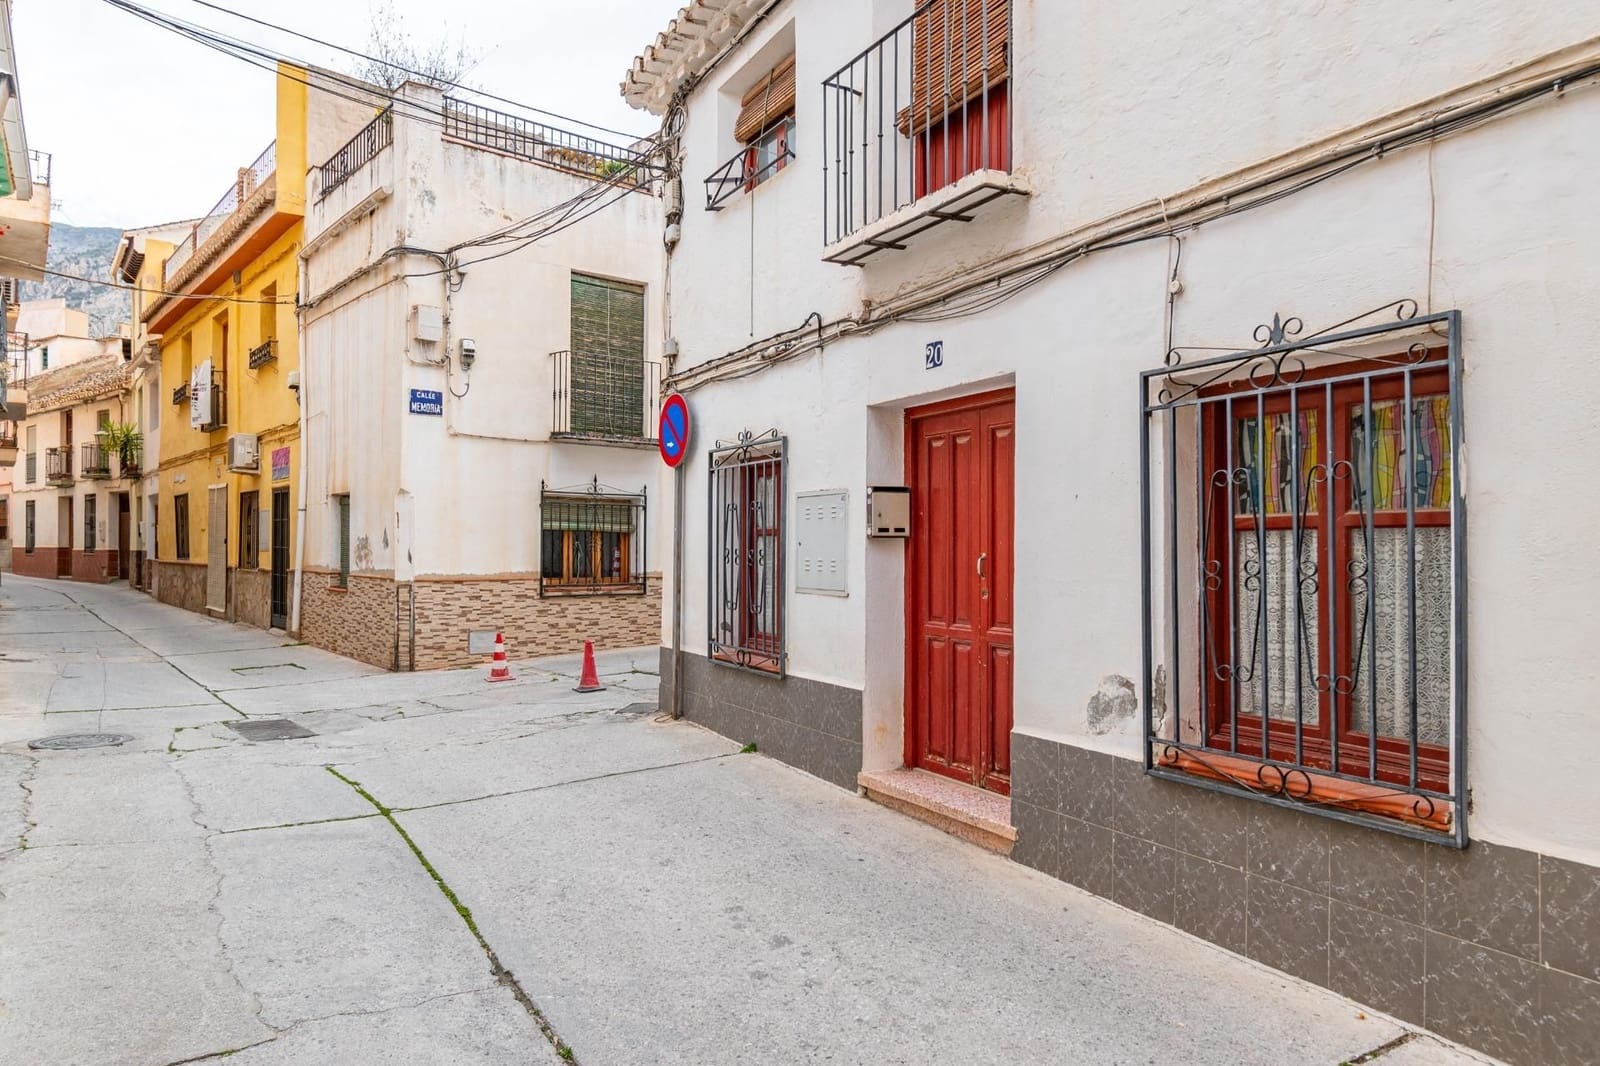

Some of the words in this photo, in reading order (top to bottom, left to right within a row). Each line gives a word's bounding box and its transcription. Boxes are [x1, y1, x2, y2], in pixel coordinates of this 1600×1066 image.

[926, 344, 943, 367] 20
[416, 391, 436, 400] CALLE
[411, 401, 441, 413] MEMORIA
